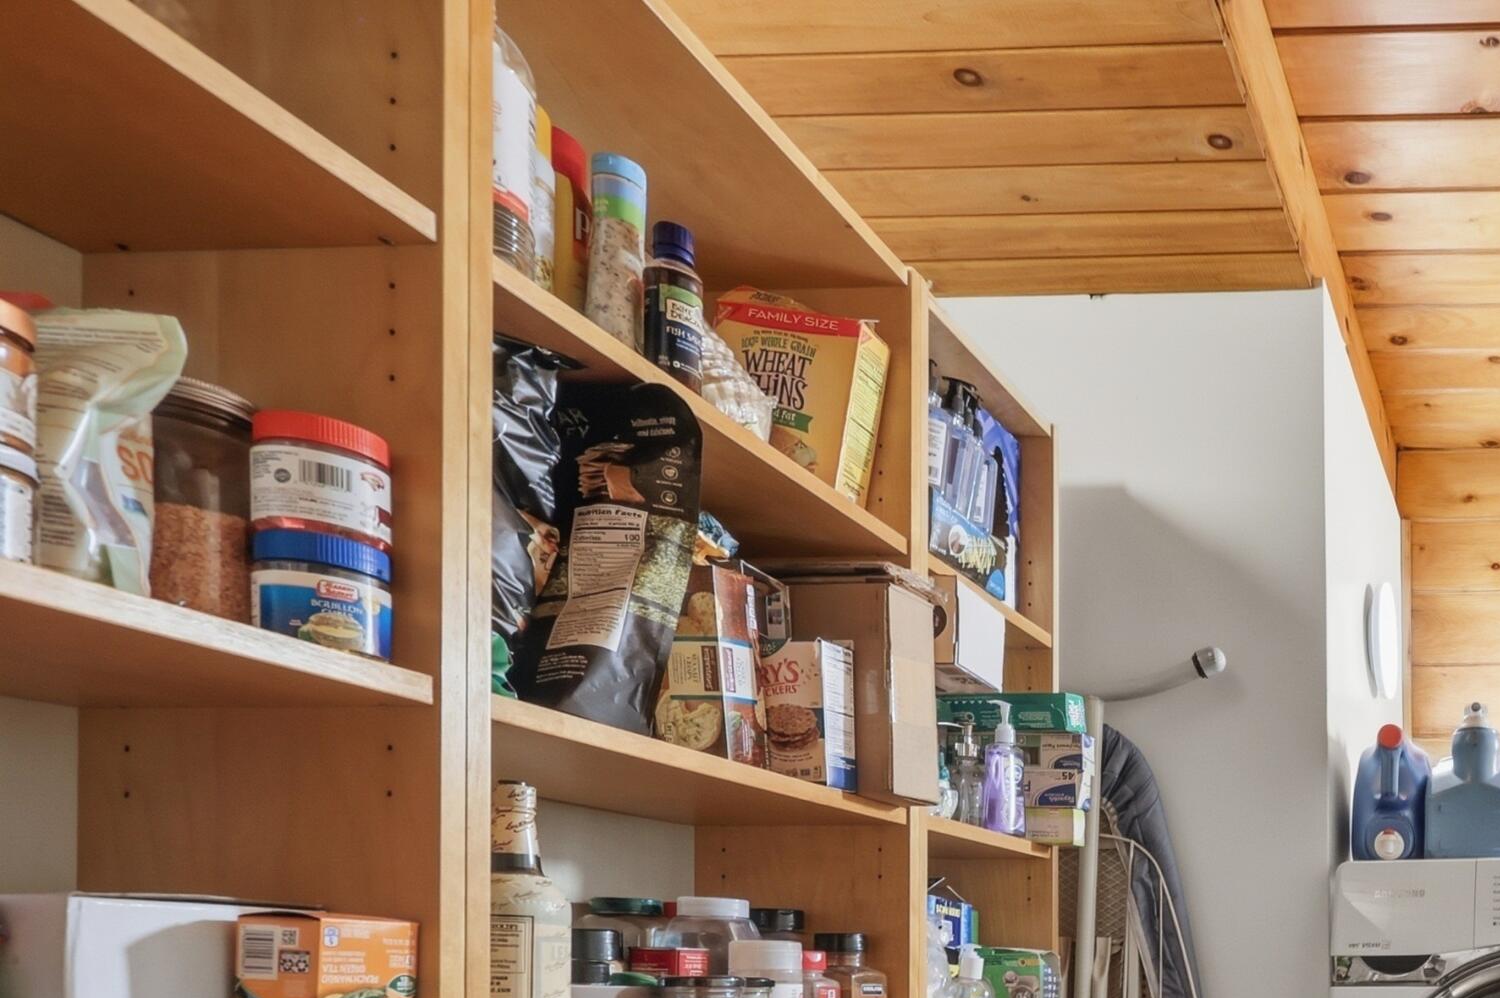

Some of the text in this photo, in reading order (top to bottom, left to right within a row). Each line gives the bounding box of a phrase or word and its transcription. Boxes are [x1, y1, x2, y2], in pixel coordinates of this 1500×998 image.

[748, 308, 839, 331] FAMILY SIZE
[760, 336, 789, 350] WHOLE
[790, 339, 817, 358] GRAIN
[742, 349, 813, 381] WHEAT
[757, 658, 800, 686] RY'S
[764, 683, 798, 697] CKERS
